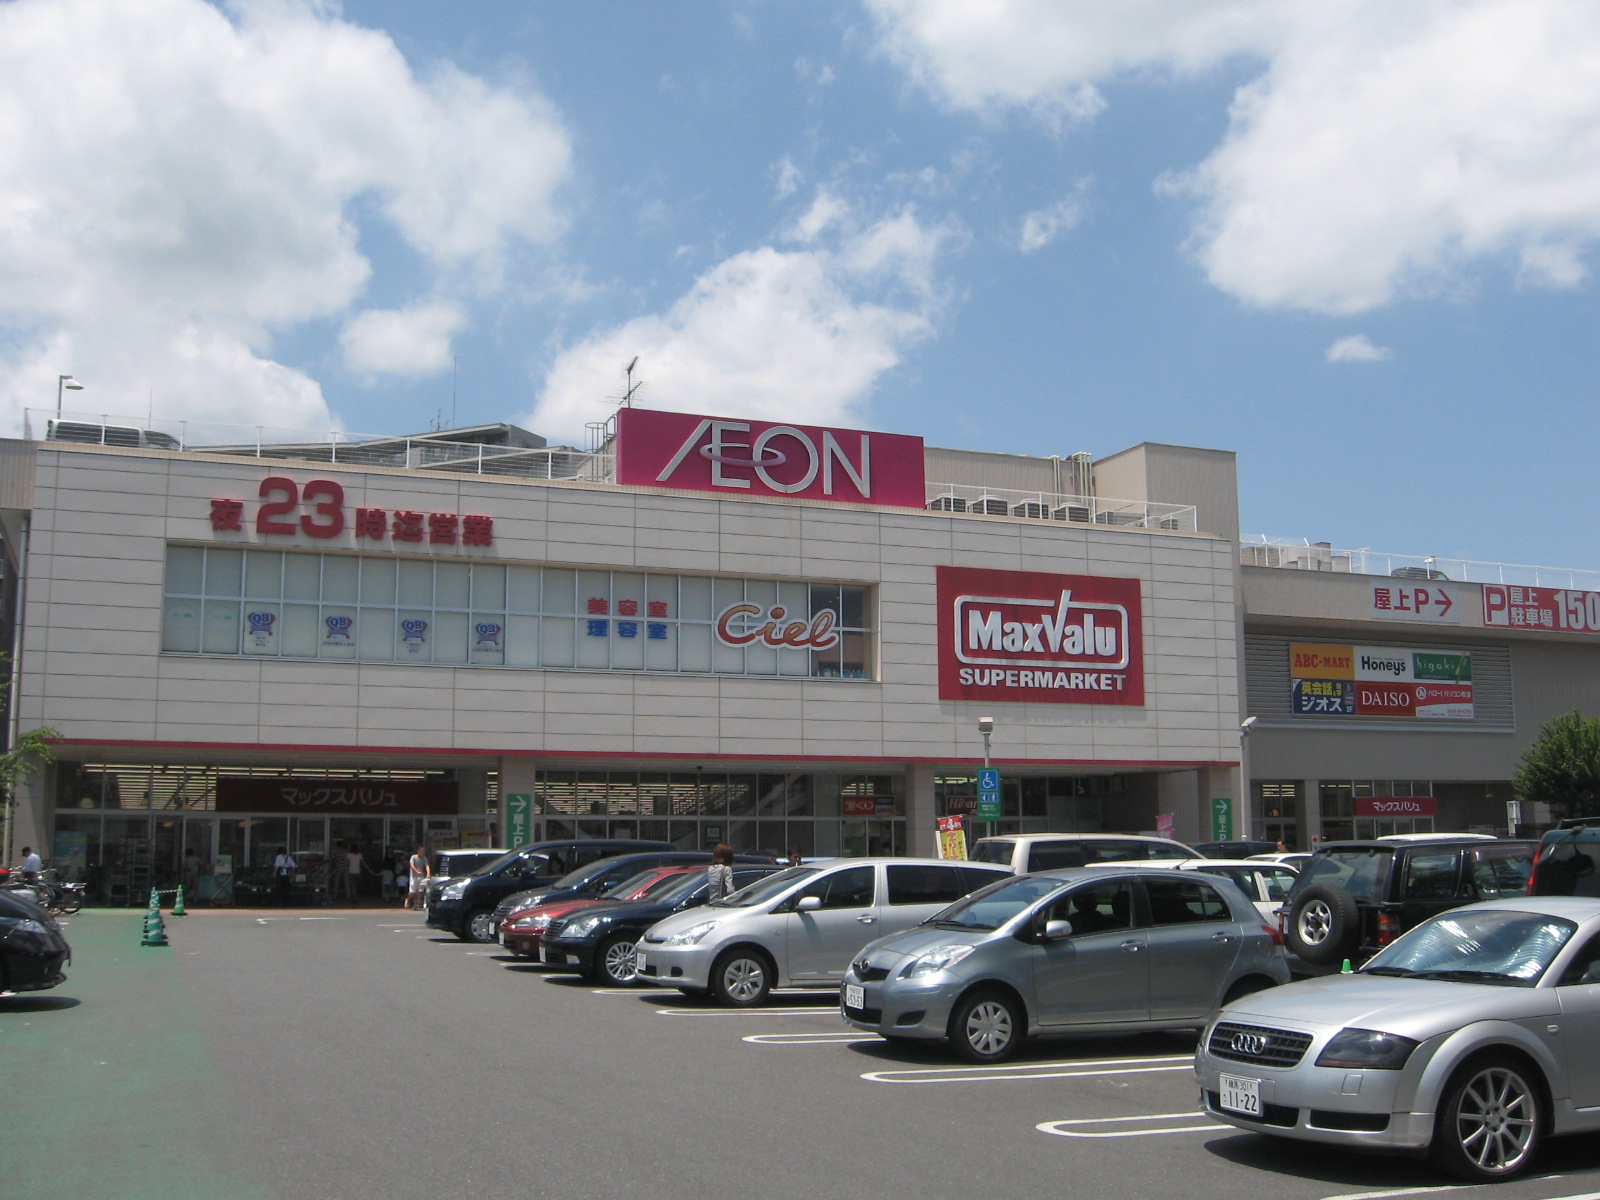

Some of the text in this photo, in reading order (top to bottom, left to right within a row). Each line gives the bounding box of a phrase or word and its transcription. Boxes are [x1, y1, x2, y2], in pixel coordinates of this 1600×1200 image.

[1510, 587, 1538, 606] 屋上
[587, 597, 668, 618] 美容室
[1511, 607, 1553, 627] 駐車場
[252, 613, 270, 624] QB
[329, 617, 347, 627] QB
[405, 620, 422, 632] QB
[716, 603, 838, 649] Ciel
[968, 590, 1117, 657] MaxValu
[480, 624, 496, 635] QB
[587, 620, 668, 640] 理容室
[1294, 653, 1351, 669] ABC-MART
[1361, 655, 1406, 676] Honeys
[1416, 656, 1454, 673] higaki
[959, 668, 1126, 691] SUPERMARKET
[1301, 696, 1342, 712] ジオス
[1362, 691, 1410, 706] DAISO
[281, 788, 398, 807] マックスバリュ
[1373, 802, 1421, 812] マックスバリュ
[1229, 1090, 1257, 1111] 11-22
